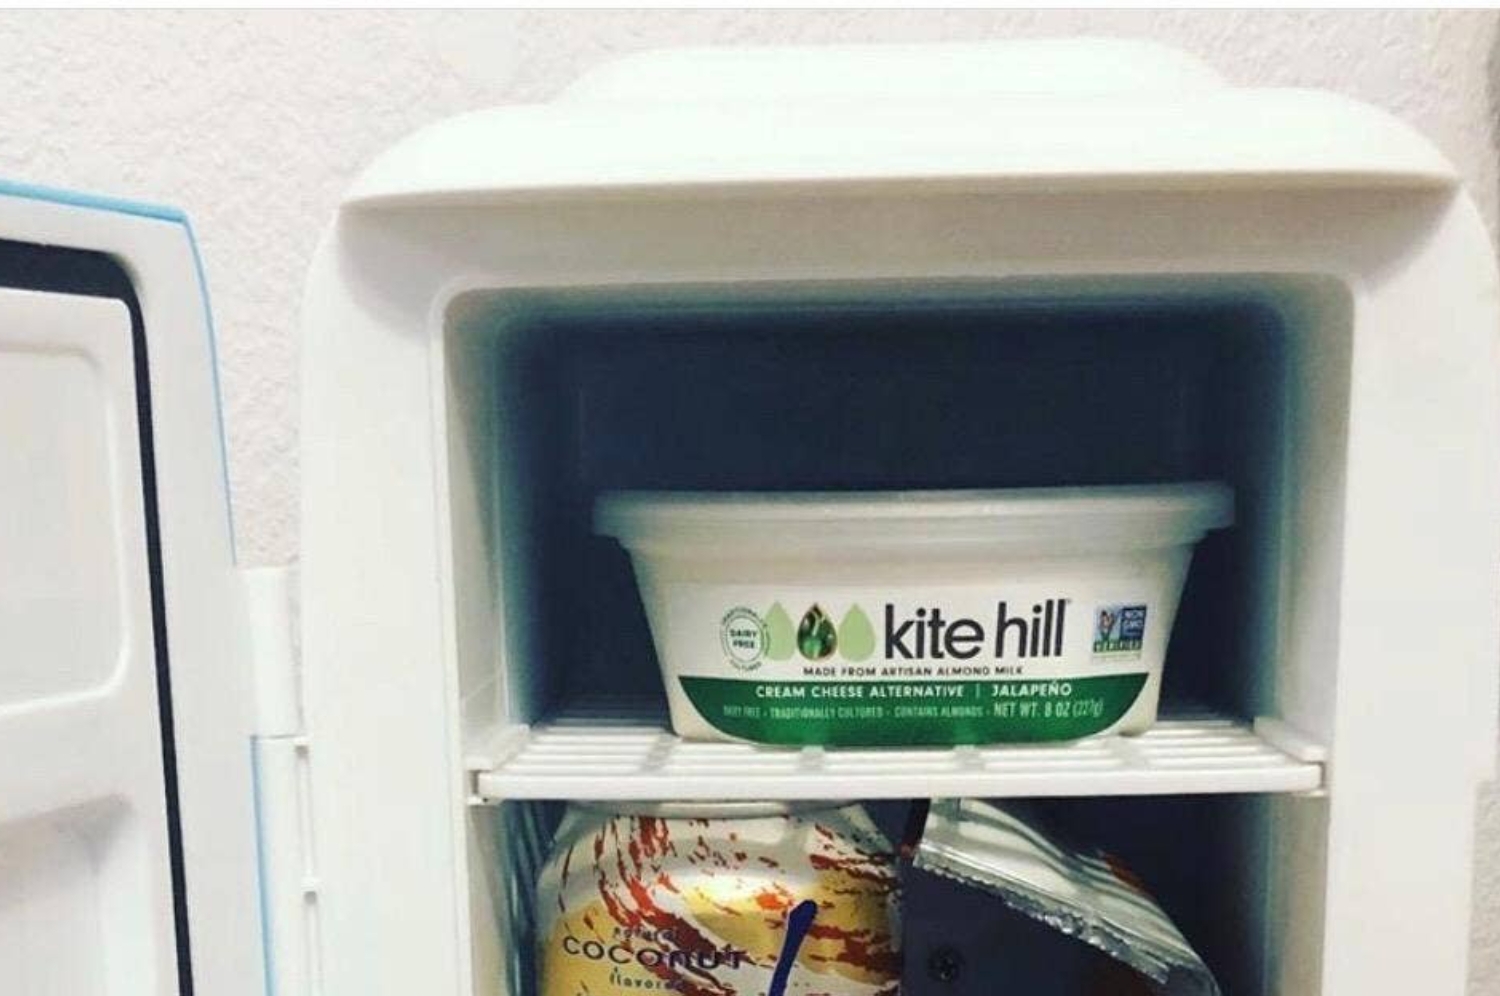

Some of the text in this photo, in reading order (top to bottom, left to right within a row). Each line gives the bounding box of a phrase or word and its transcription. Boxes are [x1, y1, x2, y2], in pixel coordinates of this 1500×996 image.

[885, 598, 1066, 660] kite hill
[803, 666, 1023, 677] MADE FROM ARTISAN ALMOND MILK
[755, 679, 1072, 698] CREAM CHEESE ALTERNATIVE JALAPEÑO
[994, 702, 1015, 717] NET
[1055, 702, 1070, 717] OZ
